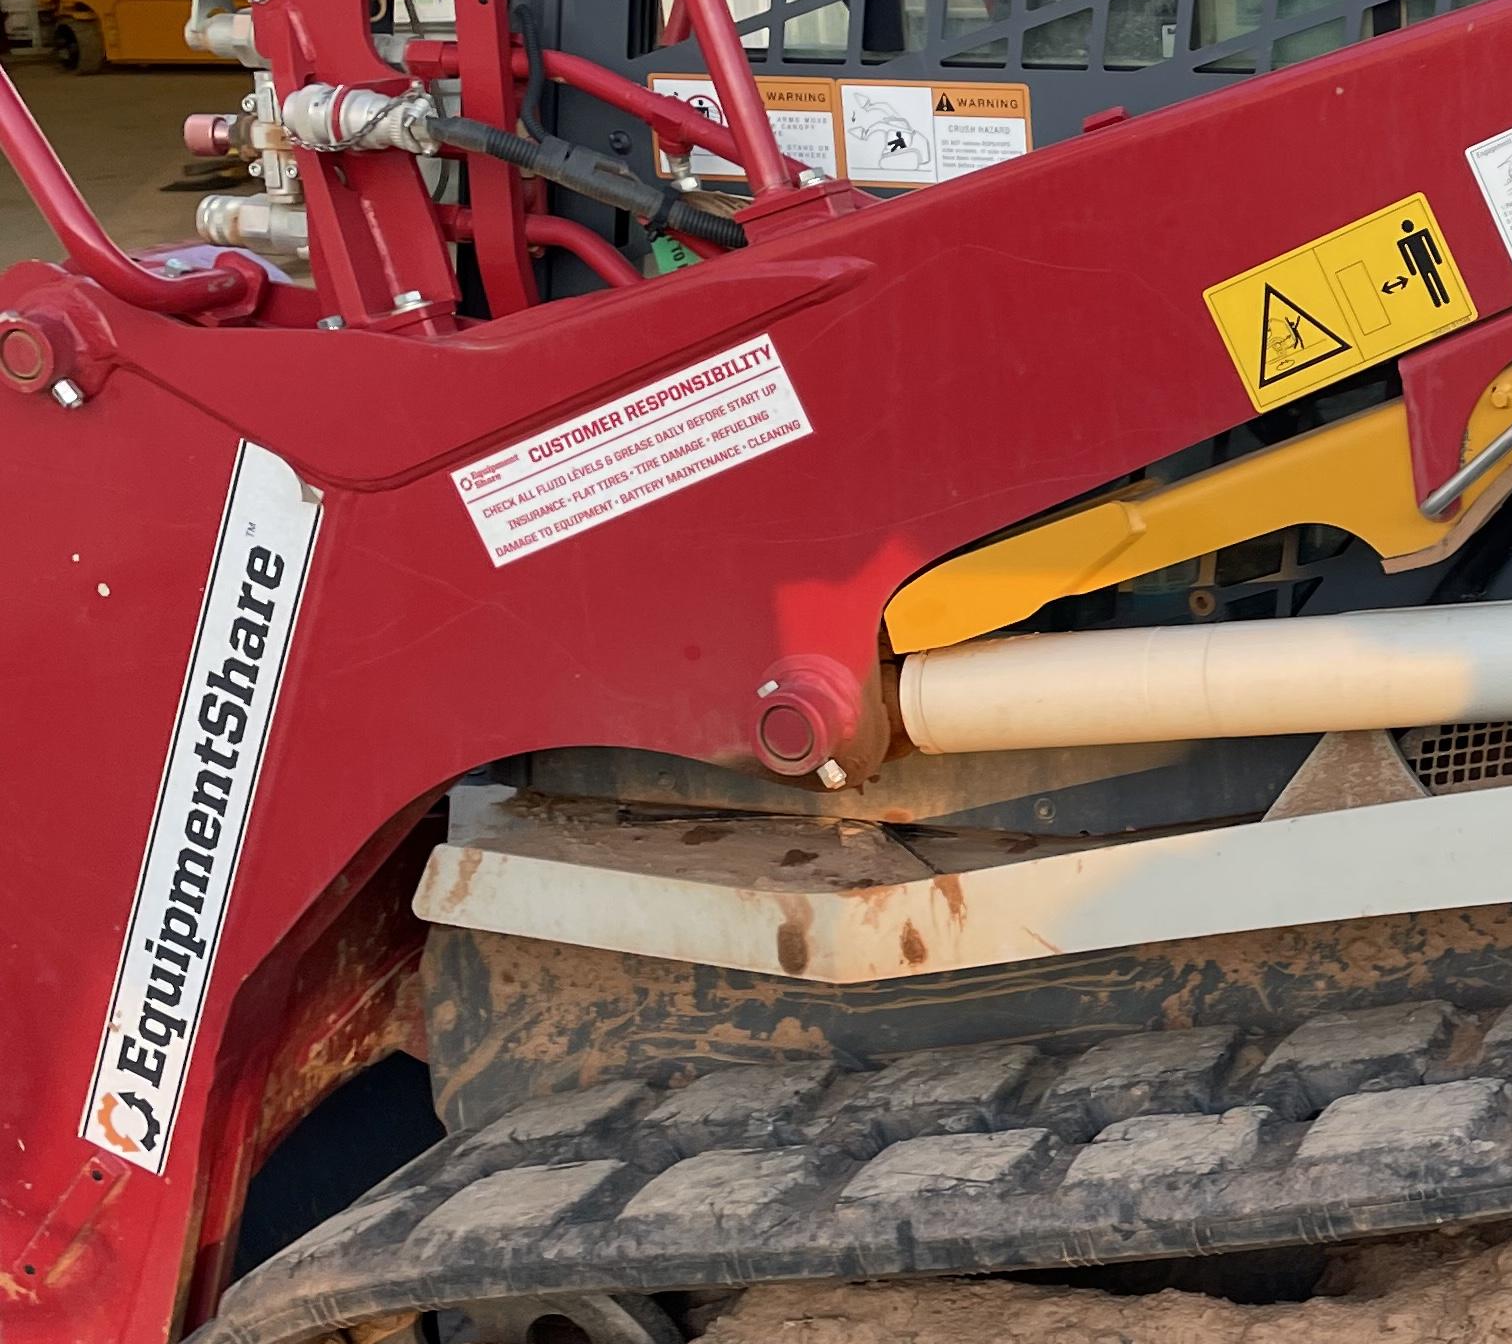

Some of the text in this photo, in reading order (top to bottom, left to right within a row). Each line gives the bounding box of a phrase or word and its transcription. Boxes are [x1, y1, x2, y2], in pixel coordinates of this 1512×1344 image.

[766, 92, 826, 103] WARNING
[947, 125, 976, 133] CRUSH
[957, 98, 1018, 109] WARNING
[481, 496, 518, 519] CHECK
[516, 488, 536, 504] ALL
[535, 474, 567, 496] FLUID
[565, 458, 604, 482] LEVELS
[612, 436, 656, 462] GREASE
[654, 422, 686, 444] DAILY
[685, 405, 727, 430] BEFORE
[725, 390, 761, 413] START
[760, 382, 779, 398] UP
[527, 344, 774, 463] CUSTOMER RESPONSIBILITY
[494, 418, 802, 558] DAMAGE TO EQUIPMENT BATTERY MAINTENANCE CLEANING
[506, 409, 770, 530] INSURANCE FLAT TIRES TIRE DAMAGE REFUELING
[117, 545, 285, 1090] EquipmentShare
